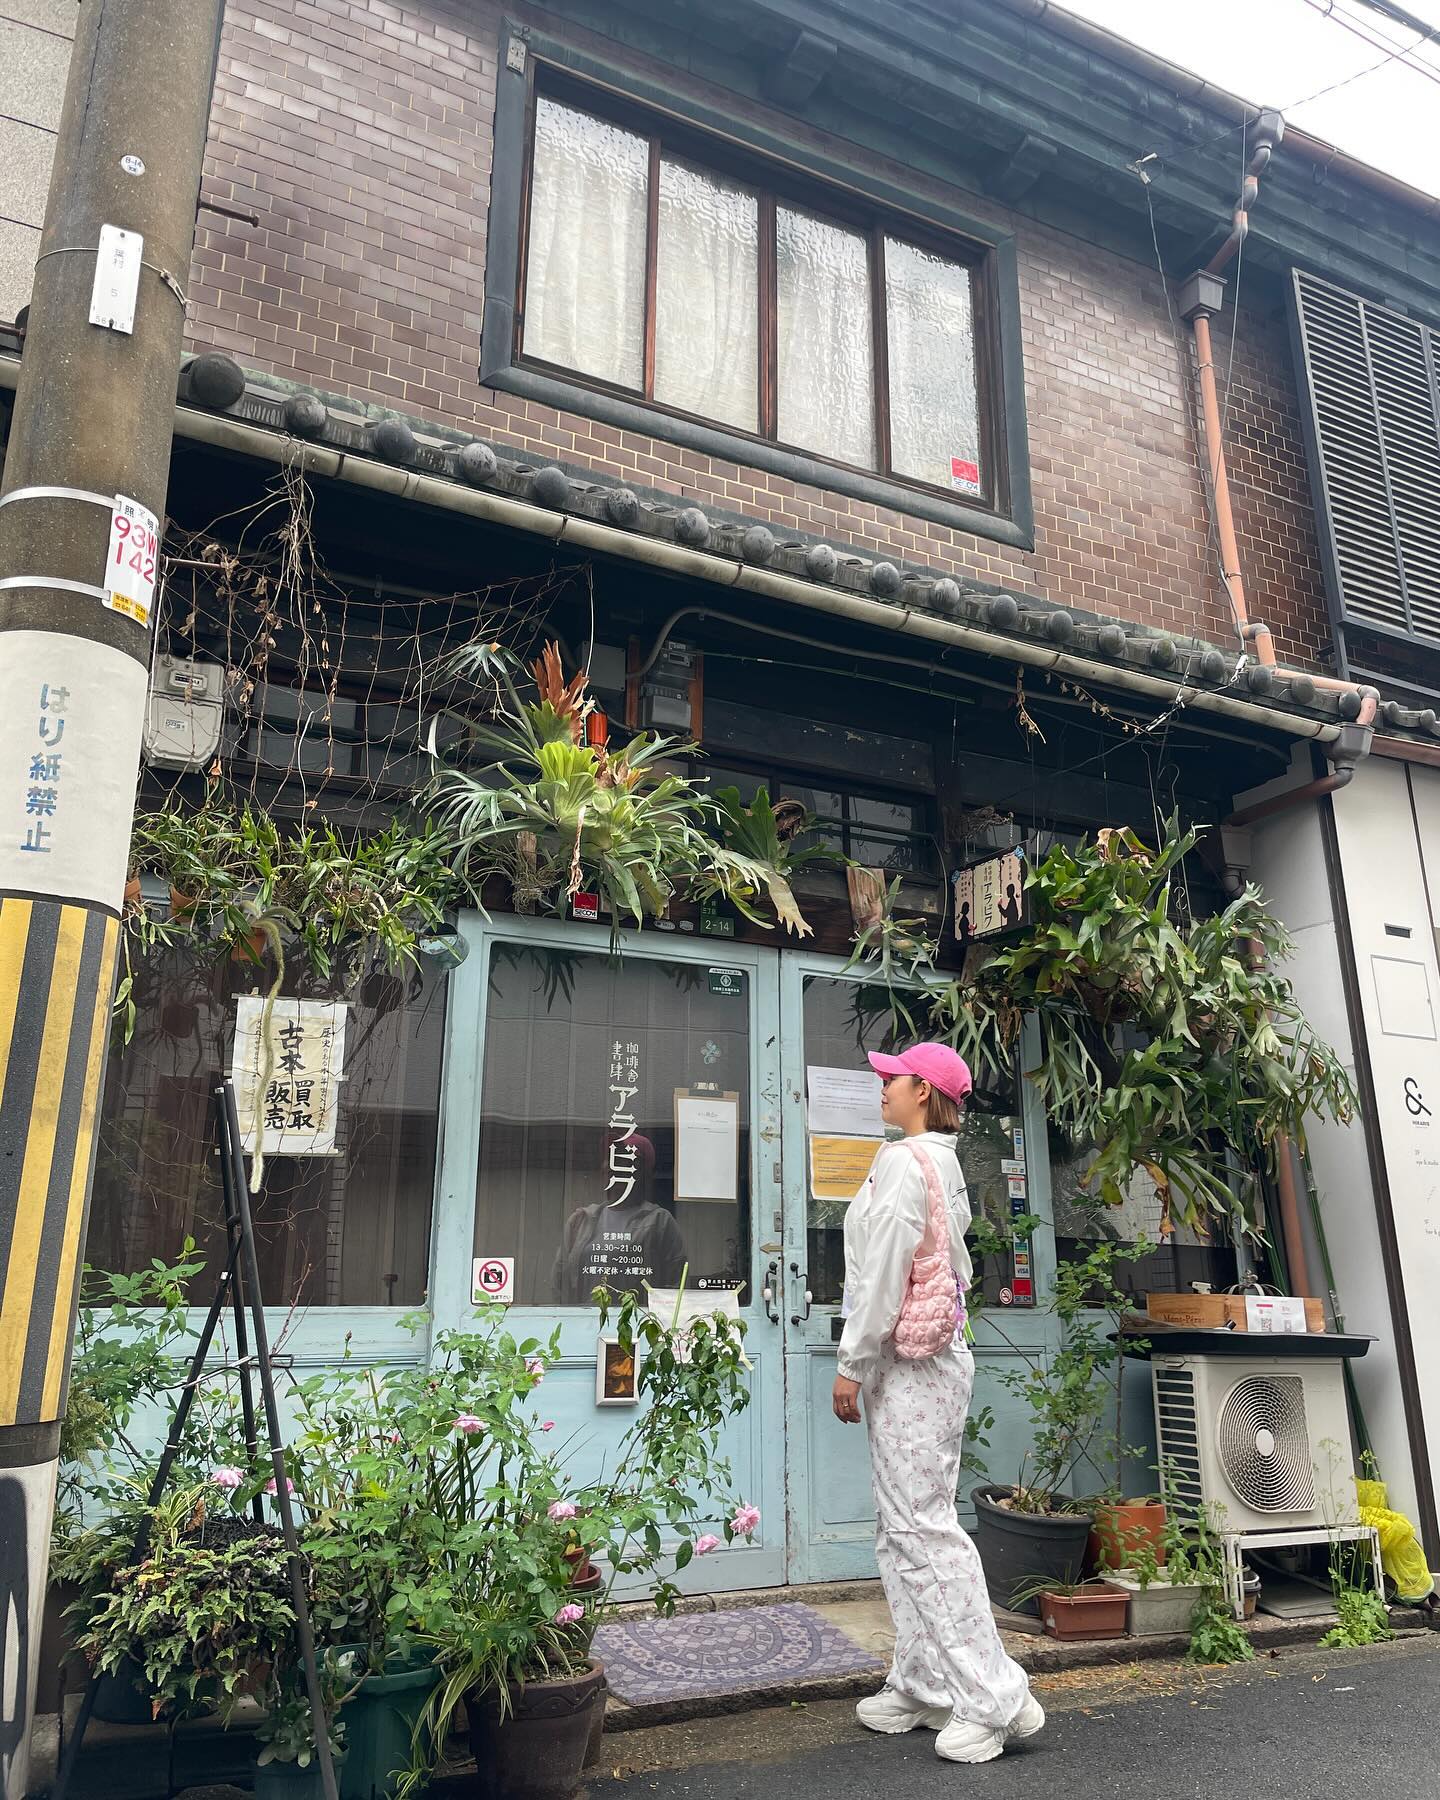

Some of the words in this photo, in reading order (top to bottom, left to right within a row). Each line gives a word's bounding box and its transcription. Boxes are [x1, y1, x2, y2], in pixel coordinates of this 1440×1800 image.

[115, 515, 157, 558] 93W
[116, 541, 155, 585] 142
[21, 684, 71, 853] はり紙禁止
[705, 919, 730, 932] 2-14
[984, 881, 993, 928] アラビク
[276, 1019, 306, 1074] 古本
[263, 1080, 292, 1130] 販売
[286, 1079, 315, 1131] 買取
[604, 1084, 639, 1209] アラビク
[602, 1232, 632, 1241] 営業時間
[1016, 1267, 1029, 1275] VISA
